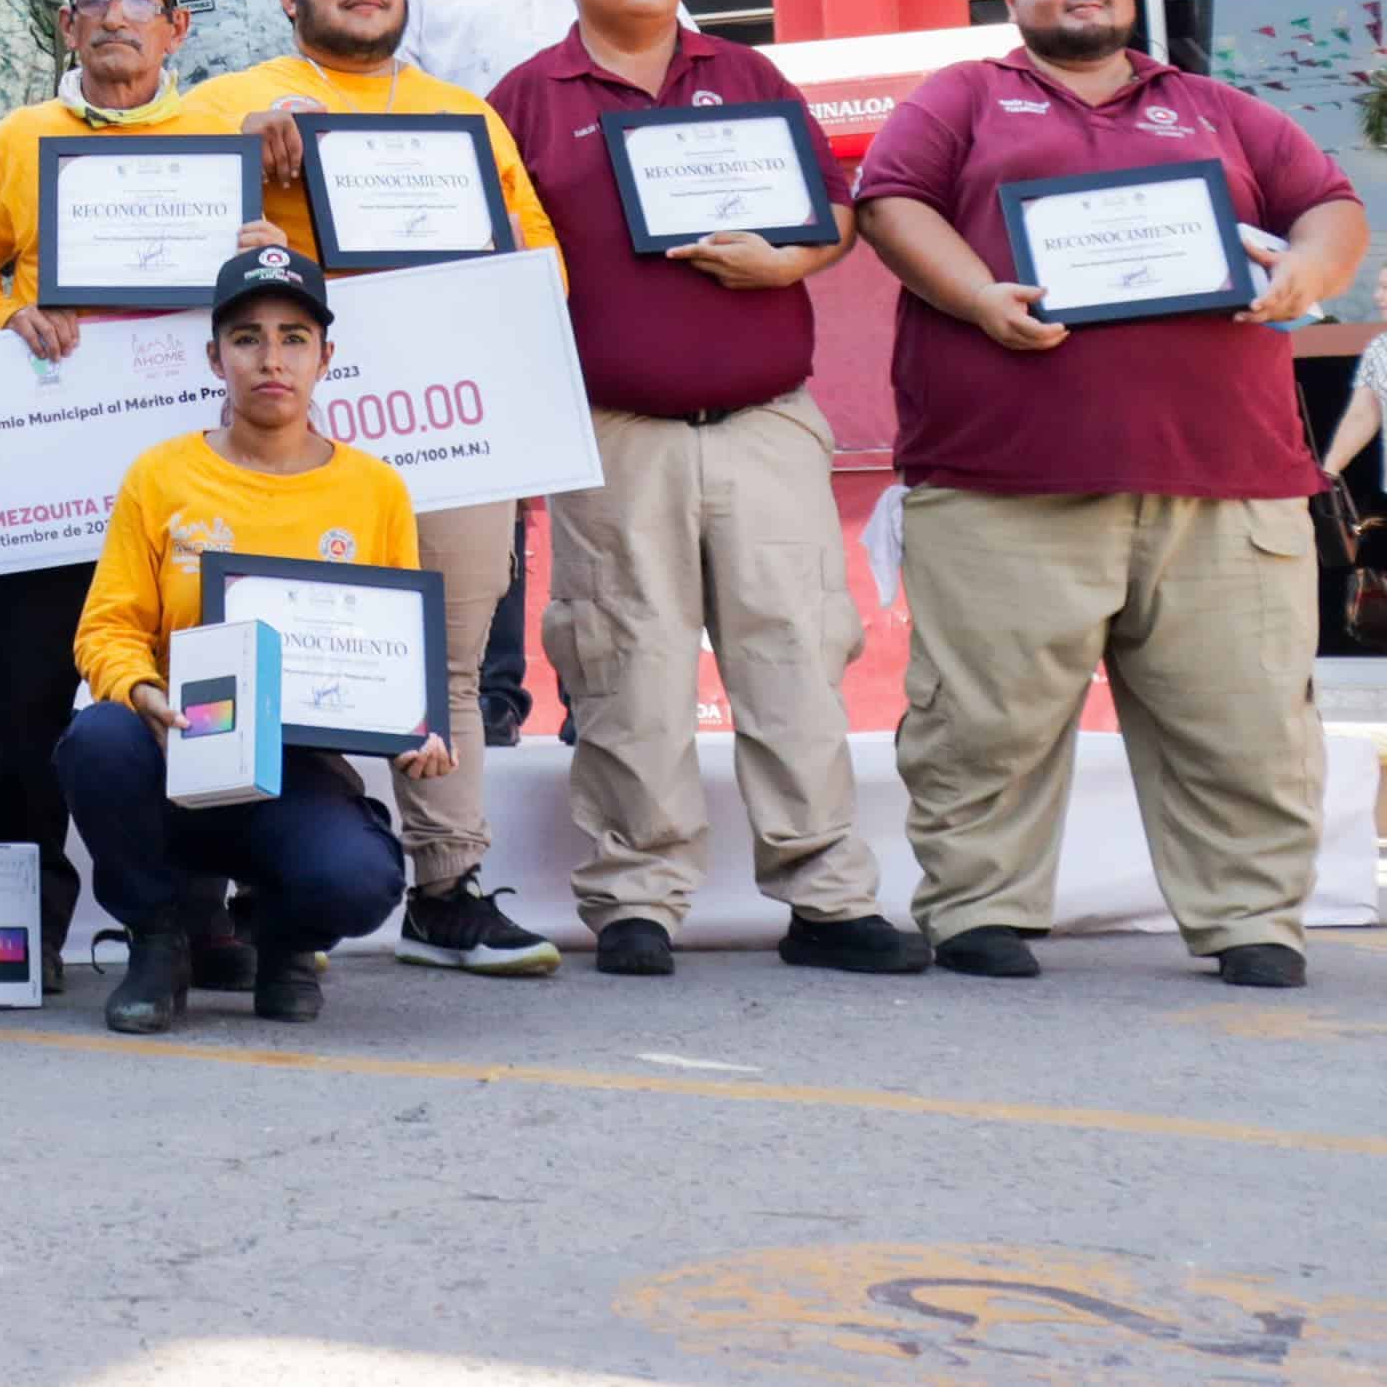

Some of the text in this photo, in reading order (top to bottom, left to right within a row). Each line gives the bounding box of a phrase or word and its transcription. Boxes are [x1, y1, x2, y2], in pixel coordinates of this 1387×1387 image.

[644, 157, 787, 179] RECONOCIMIENTO
[335, 174, 469, 188] RECONOCIMIENTO
[72, 203, 228, 219] RECONOCIMIENTO
[1044, 221, 1203, 252] RECONOCIMIENTO
[29, 402, 103, 426] Municipal
[107, 399, 121, 413] al
[126, 393, 174, 412] Mérito
[178, 389, 196, 403] de
[326, 365, 360, 381] 2023
[395, 447, 448, 466] 00/100
[63, 523, 82, 538] de
